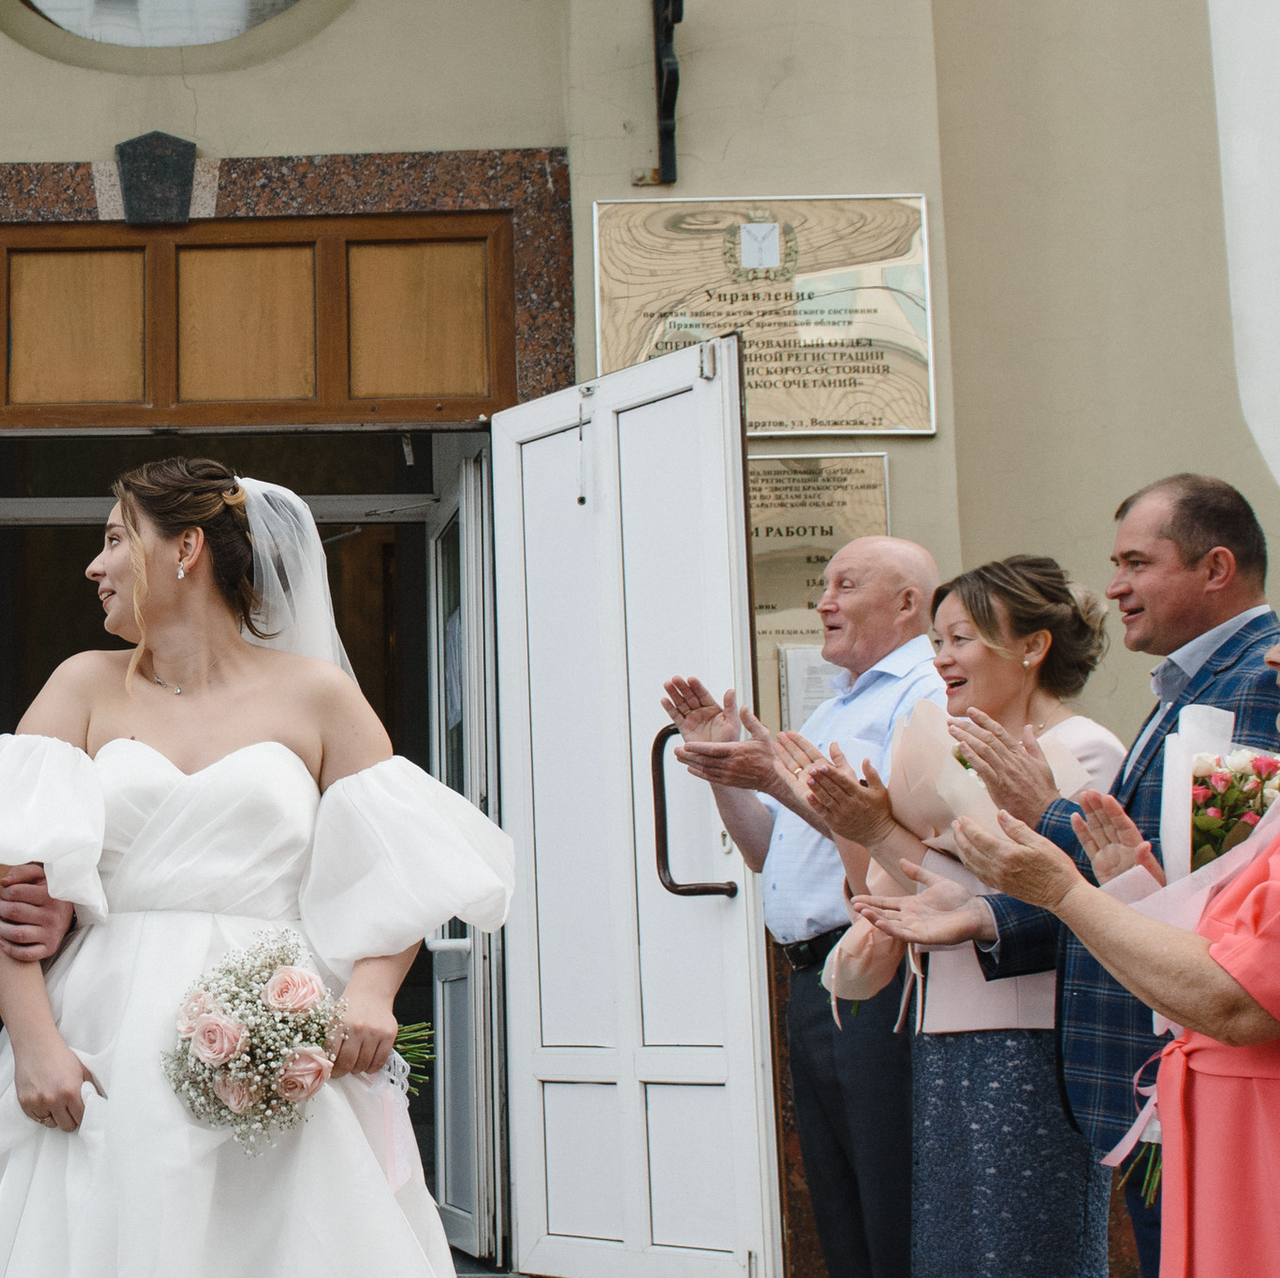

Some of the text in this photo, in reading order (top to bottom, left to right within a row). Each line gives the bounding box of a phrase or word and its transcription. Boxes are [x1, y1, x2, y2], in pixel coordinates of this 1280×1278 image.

[705, 290, 815, 304] Управление
[690, 310, 723, 318] записи
[756, 309, 825, 317] гражданского
[668, 319, 853, 330] Правительства Саратовской области
[828, 338, 873, 348] ОТДЕЛ
[787, 351, 884, 362] РЕГИСТРАЦИИ
[806, 364, 890, 375] СОСТОЯНИЯ
[748, 420, 788, 429] аратов,
[765, 525, 834, 538] РАБОТЫ
